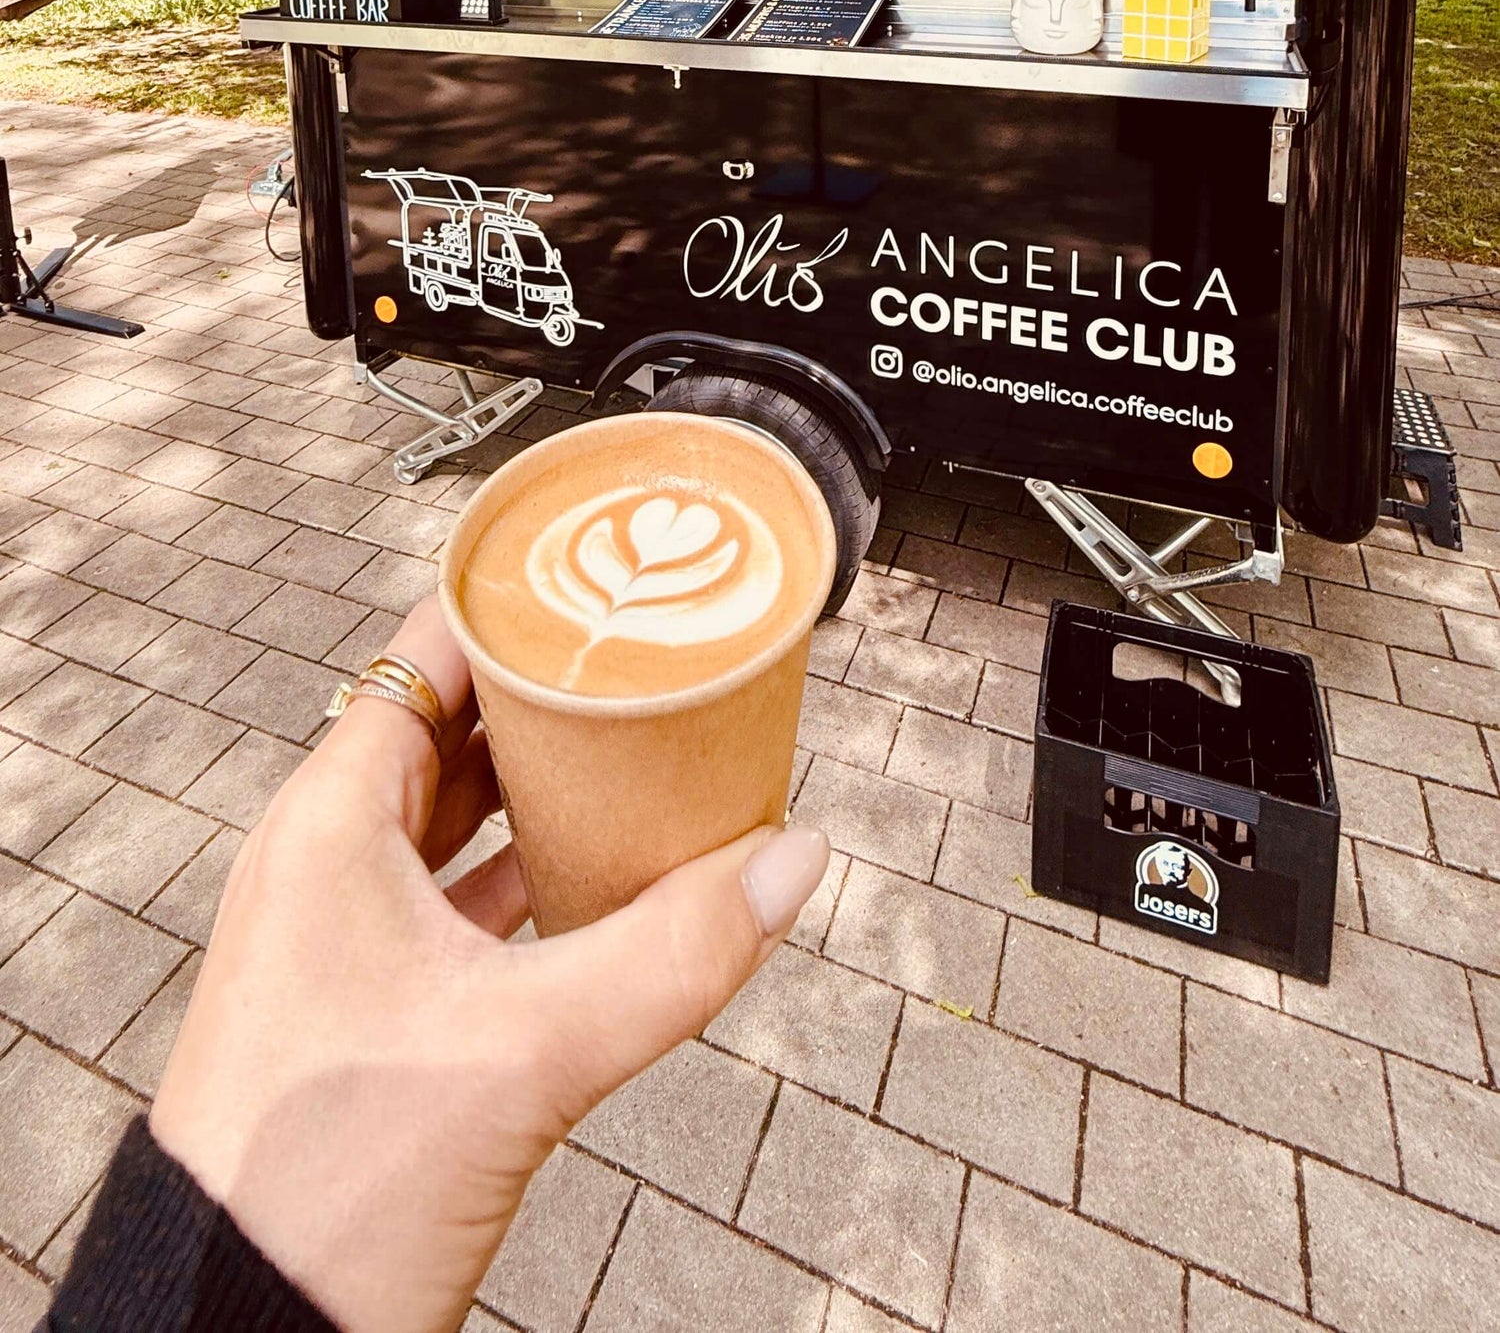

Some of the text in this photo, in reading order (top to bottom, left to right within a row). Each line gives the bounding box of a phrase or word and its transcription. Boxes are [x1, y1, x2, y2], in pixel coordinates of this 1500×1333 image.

[683, 213, 1238, 316] Olio ANGELICA
[870, 286, 1237, 377] COFFEE CLUB
[912, 360, 1234, 433] @olio.angelica.coffeeclub
